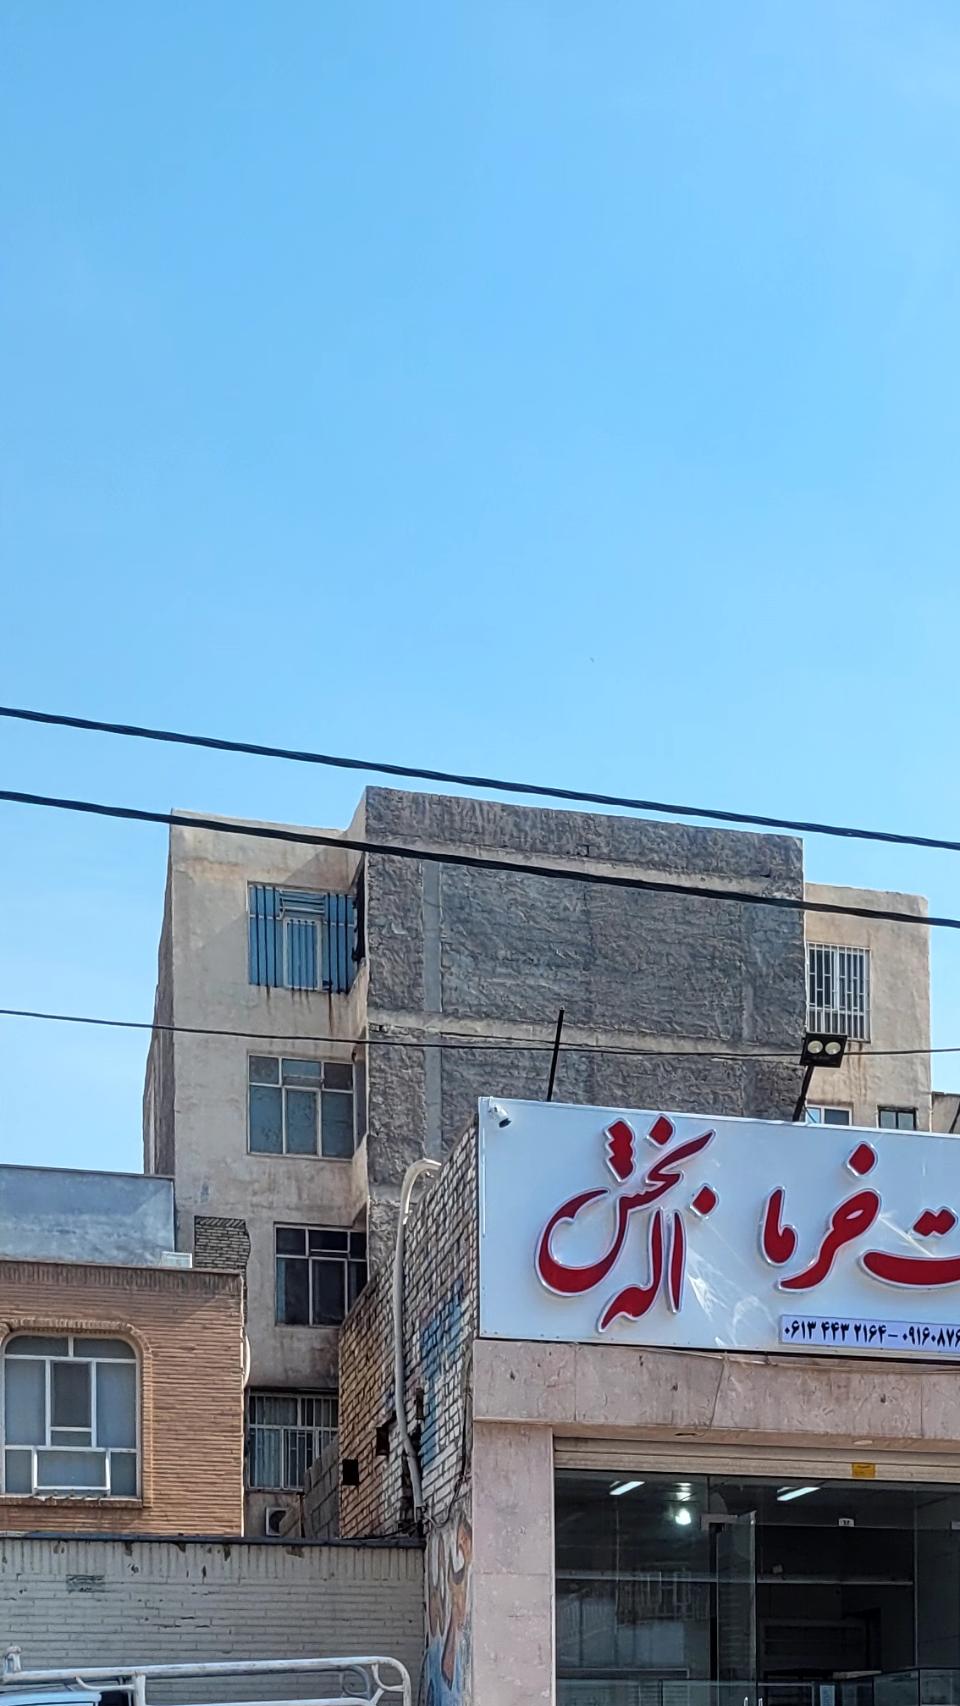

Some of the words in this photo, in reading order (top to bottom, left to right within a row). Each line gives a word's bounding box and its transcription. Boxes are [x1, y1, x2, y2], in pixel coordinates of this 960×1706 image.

[762, 1142, 880, 1290] خرما
[785, 1320, 817, 1340] ۰۶۱۳
[821, 1321, 849, 1341] ۴۴۳
